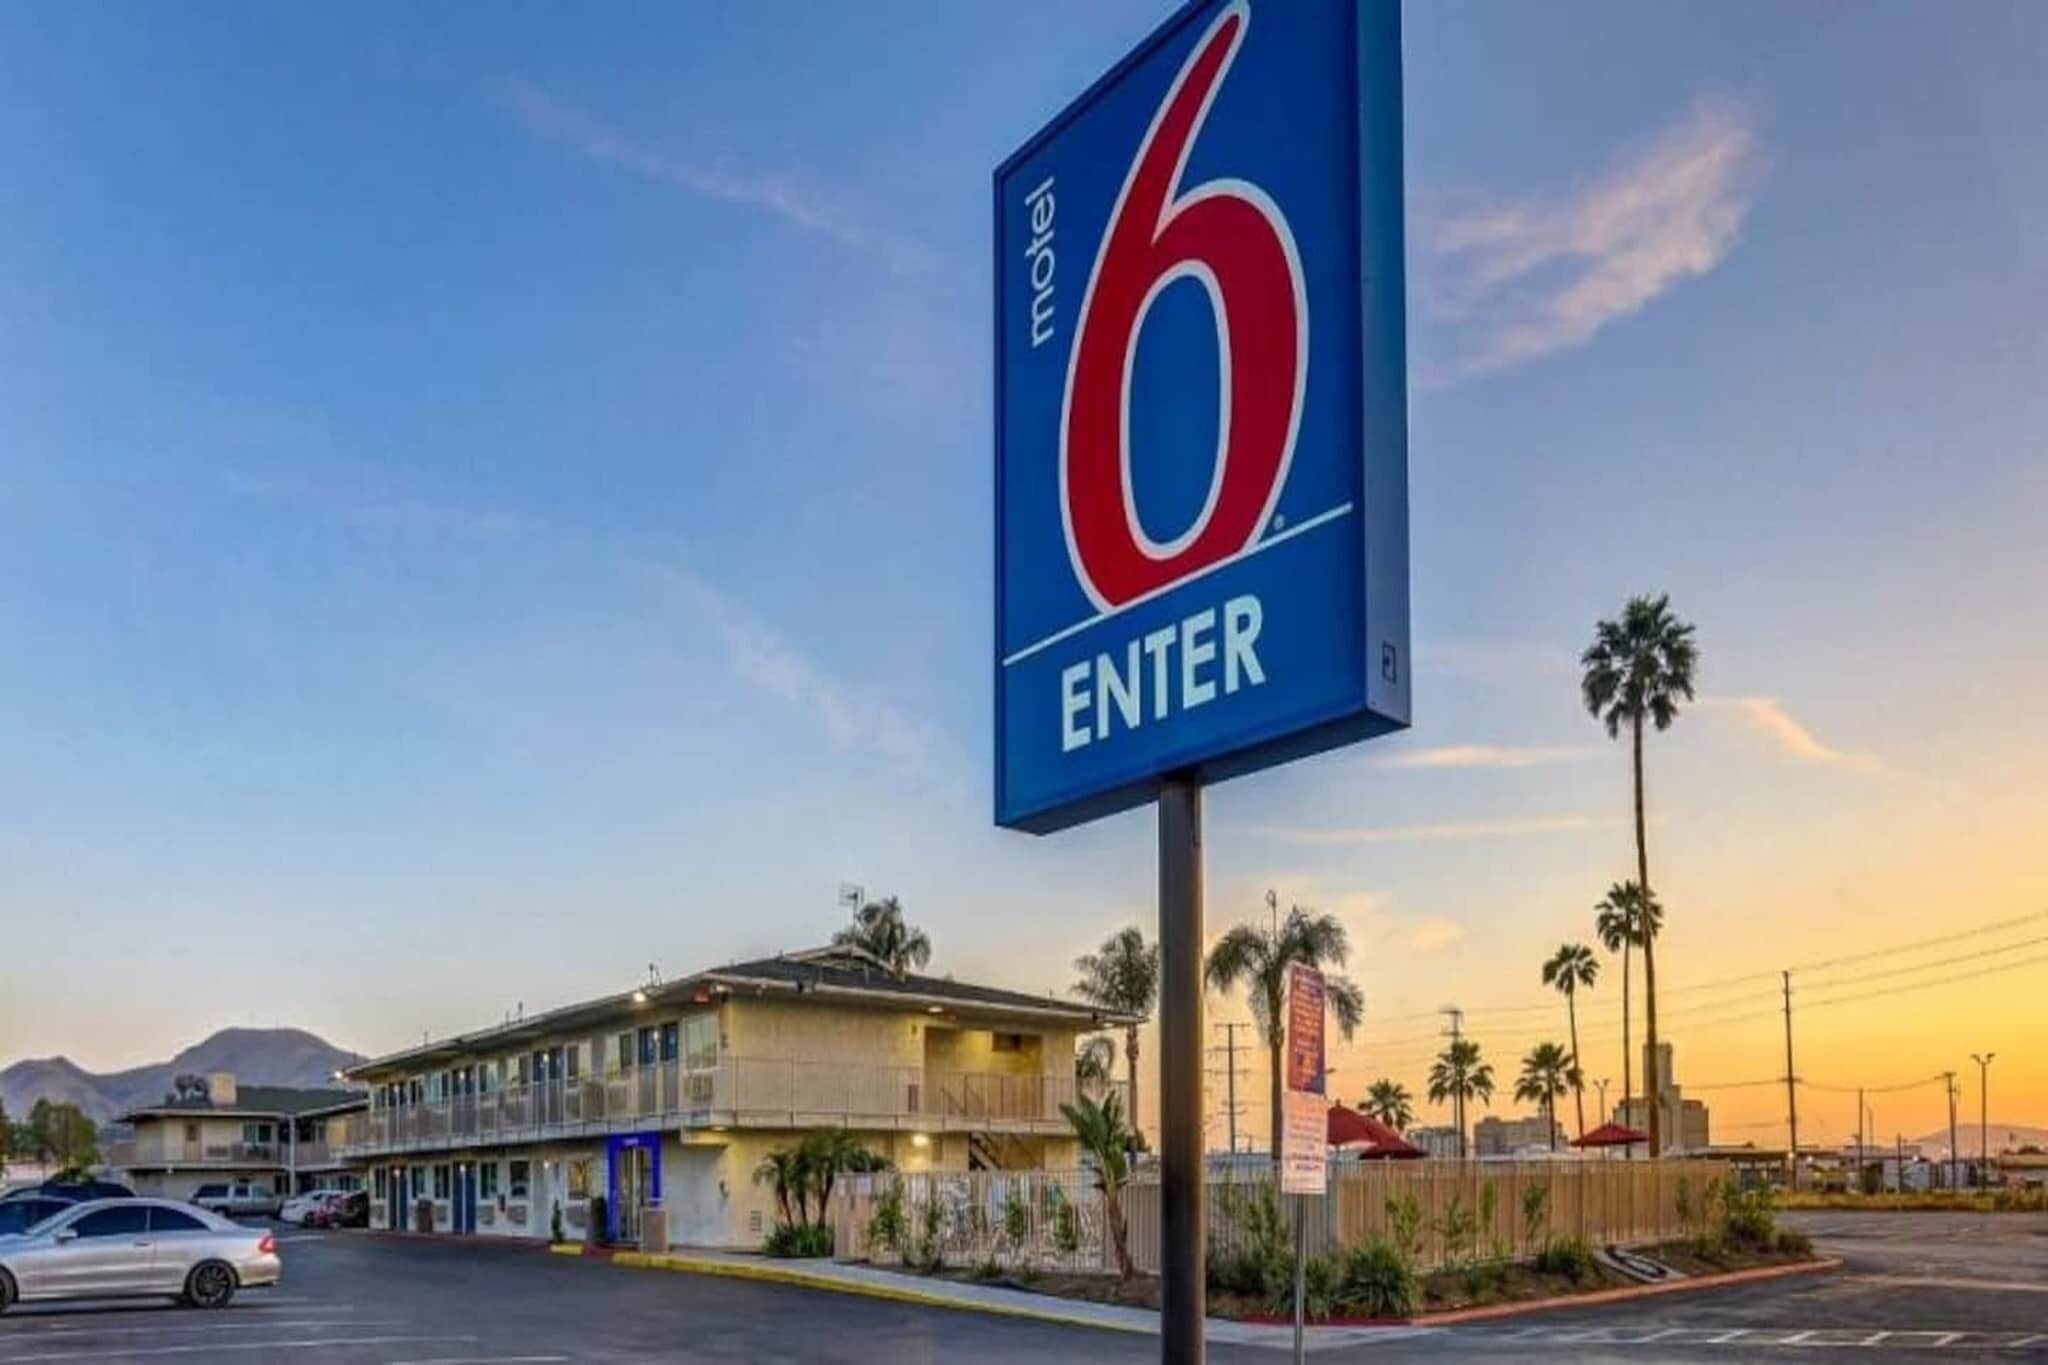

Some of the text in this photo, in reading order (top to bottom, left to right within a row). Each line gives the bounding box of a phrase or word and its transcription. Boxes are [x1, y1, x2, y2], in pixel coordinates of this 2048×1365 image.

[1025, 176, 1055, 348] motel
[1059, 0, 1308, 616] 6
[1062, 594, 1266, 752] ENTER
